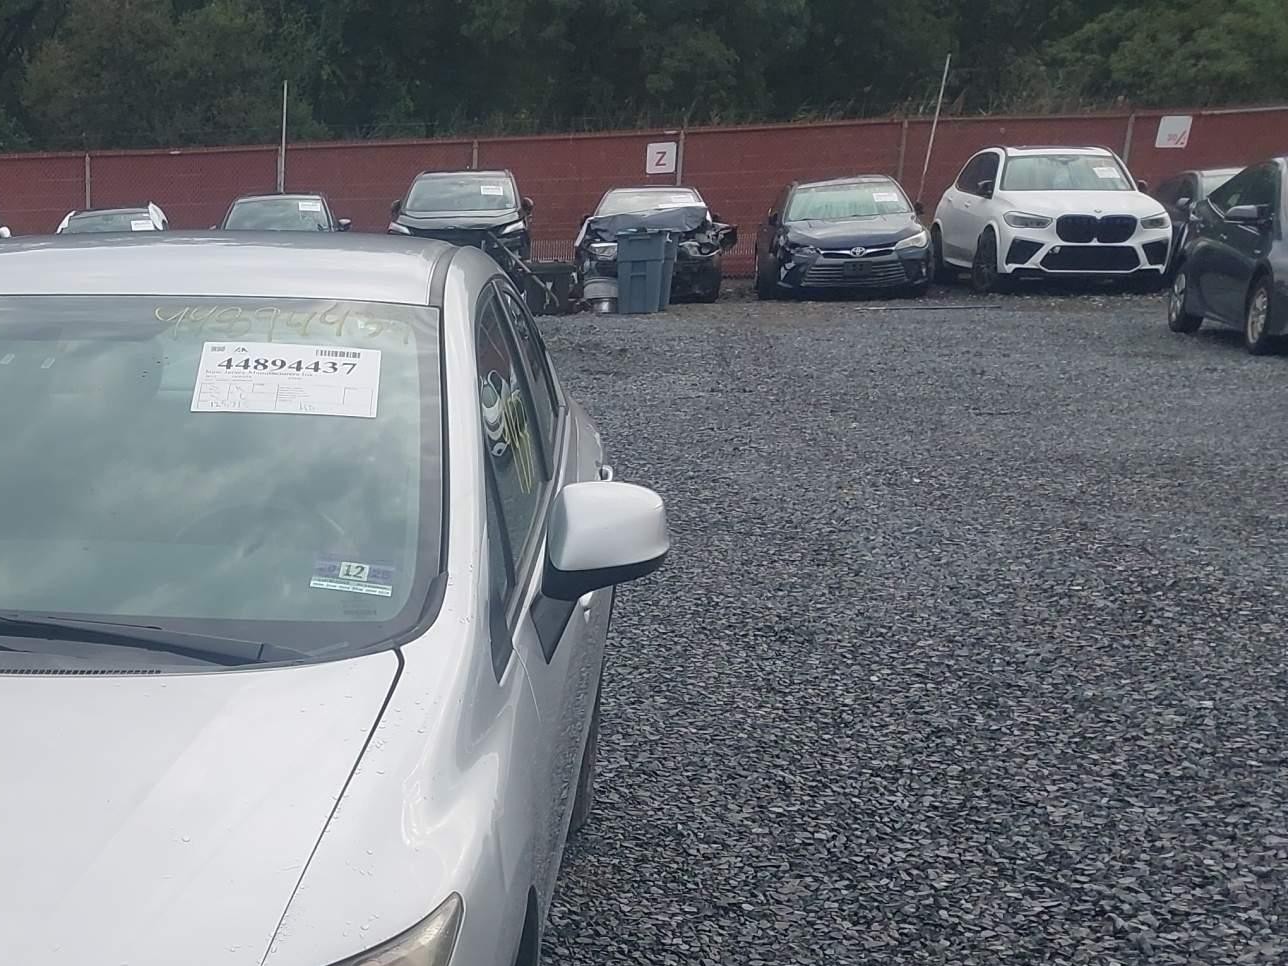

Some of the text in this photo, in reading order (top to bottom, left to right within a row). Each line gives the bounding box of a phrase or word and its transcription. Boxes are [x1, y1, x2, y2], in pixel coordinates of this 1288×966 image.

[655, 151, 666, 166] Z
[217, 357, 358, 375] 44894437
[343, 564, 365, 579] 12
